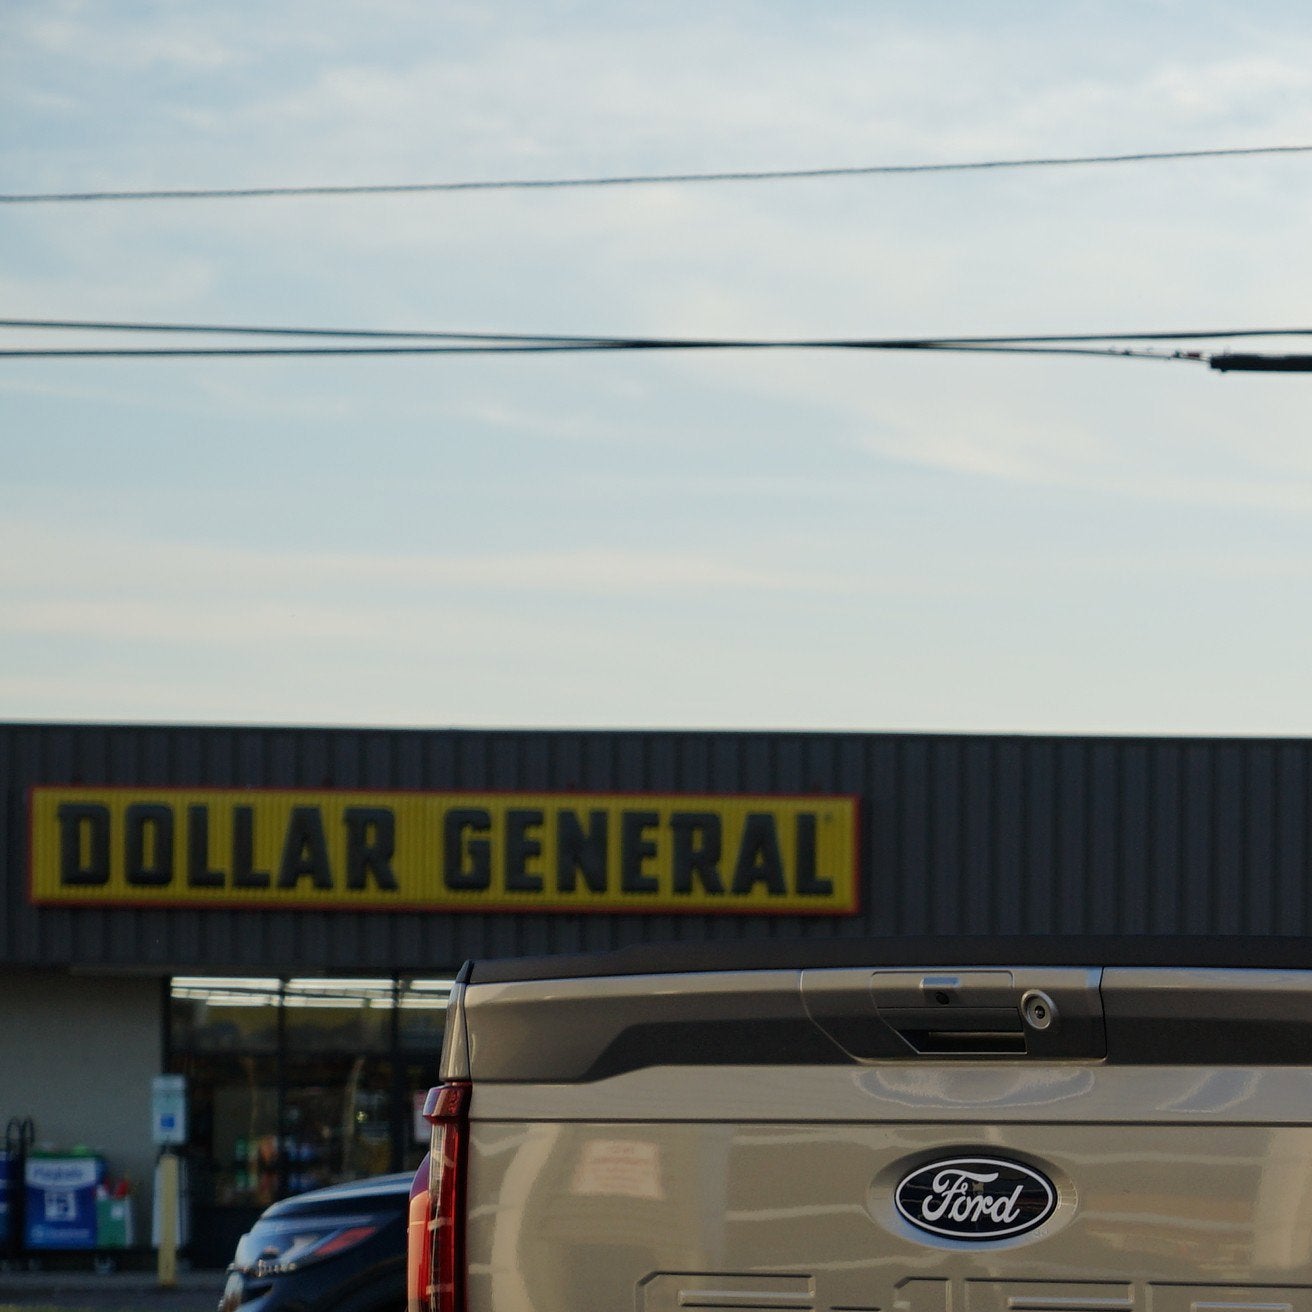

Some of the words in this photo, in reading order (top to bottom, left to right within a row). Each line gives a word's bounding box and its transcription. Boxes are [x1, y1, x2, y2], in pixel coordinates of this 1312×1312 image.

[57, 803, 398, 892] DOLLAR
[443, 808, 834, 897] GENERAL
[921, 1169, 1024, 1223] Ford
